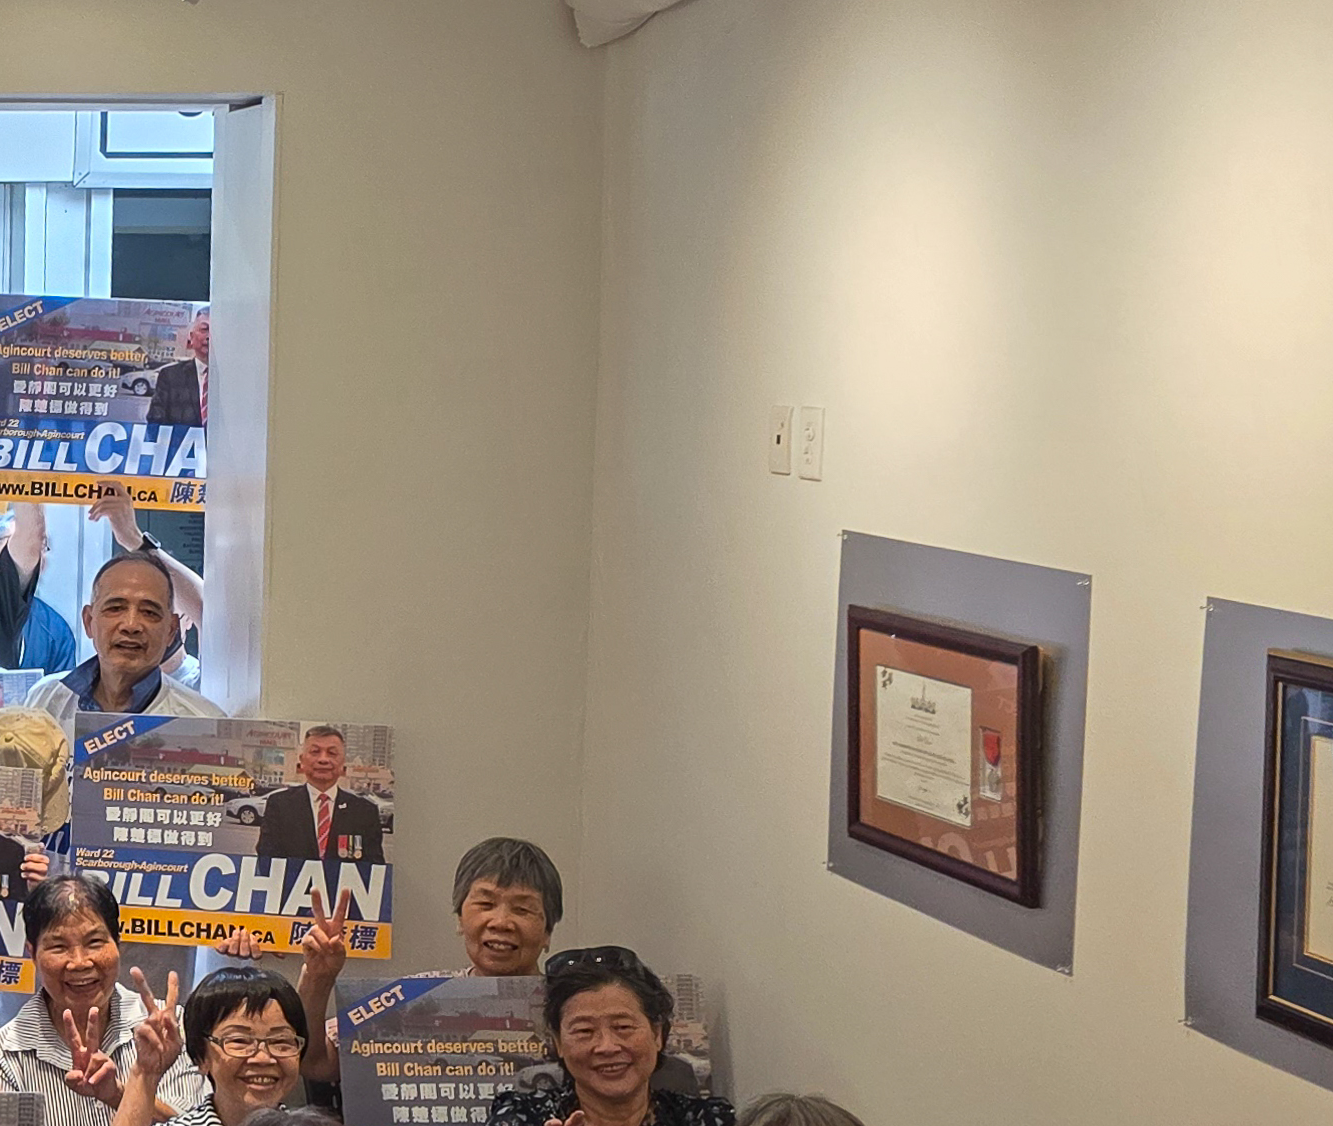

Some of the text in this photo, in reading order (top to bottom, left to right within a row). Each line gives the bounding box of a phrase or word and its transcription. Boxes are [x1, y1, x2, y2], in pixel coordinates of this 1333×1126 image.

[83, 720, 136, 755] ELECT
[84, 766, 254, 790] Agincourt deserves better,
[104, 787, 224, 807] Bill Chan do it!
[347, 984, 405, 1026] ELECT
[351, 1039, 548, 1056] Agincourt deserves better,
